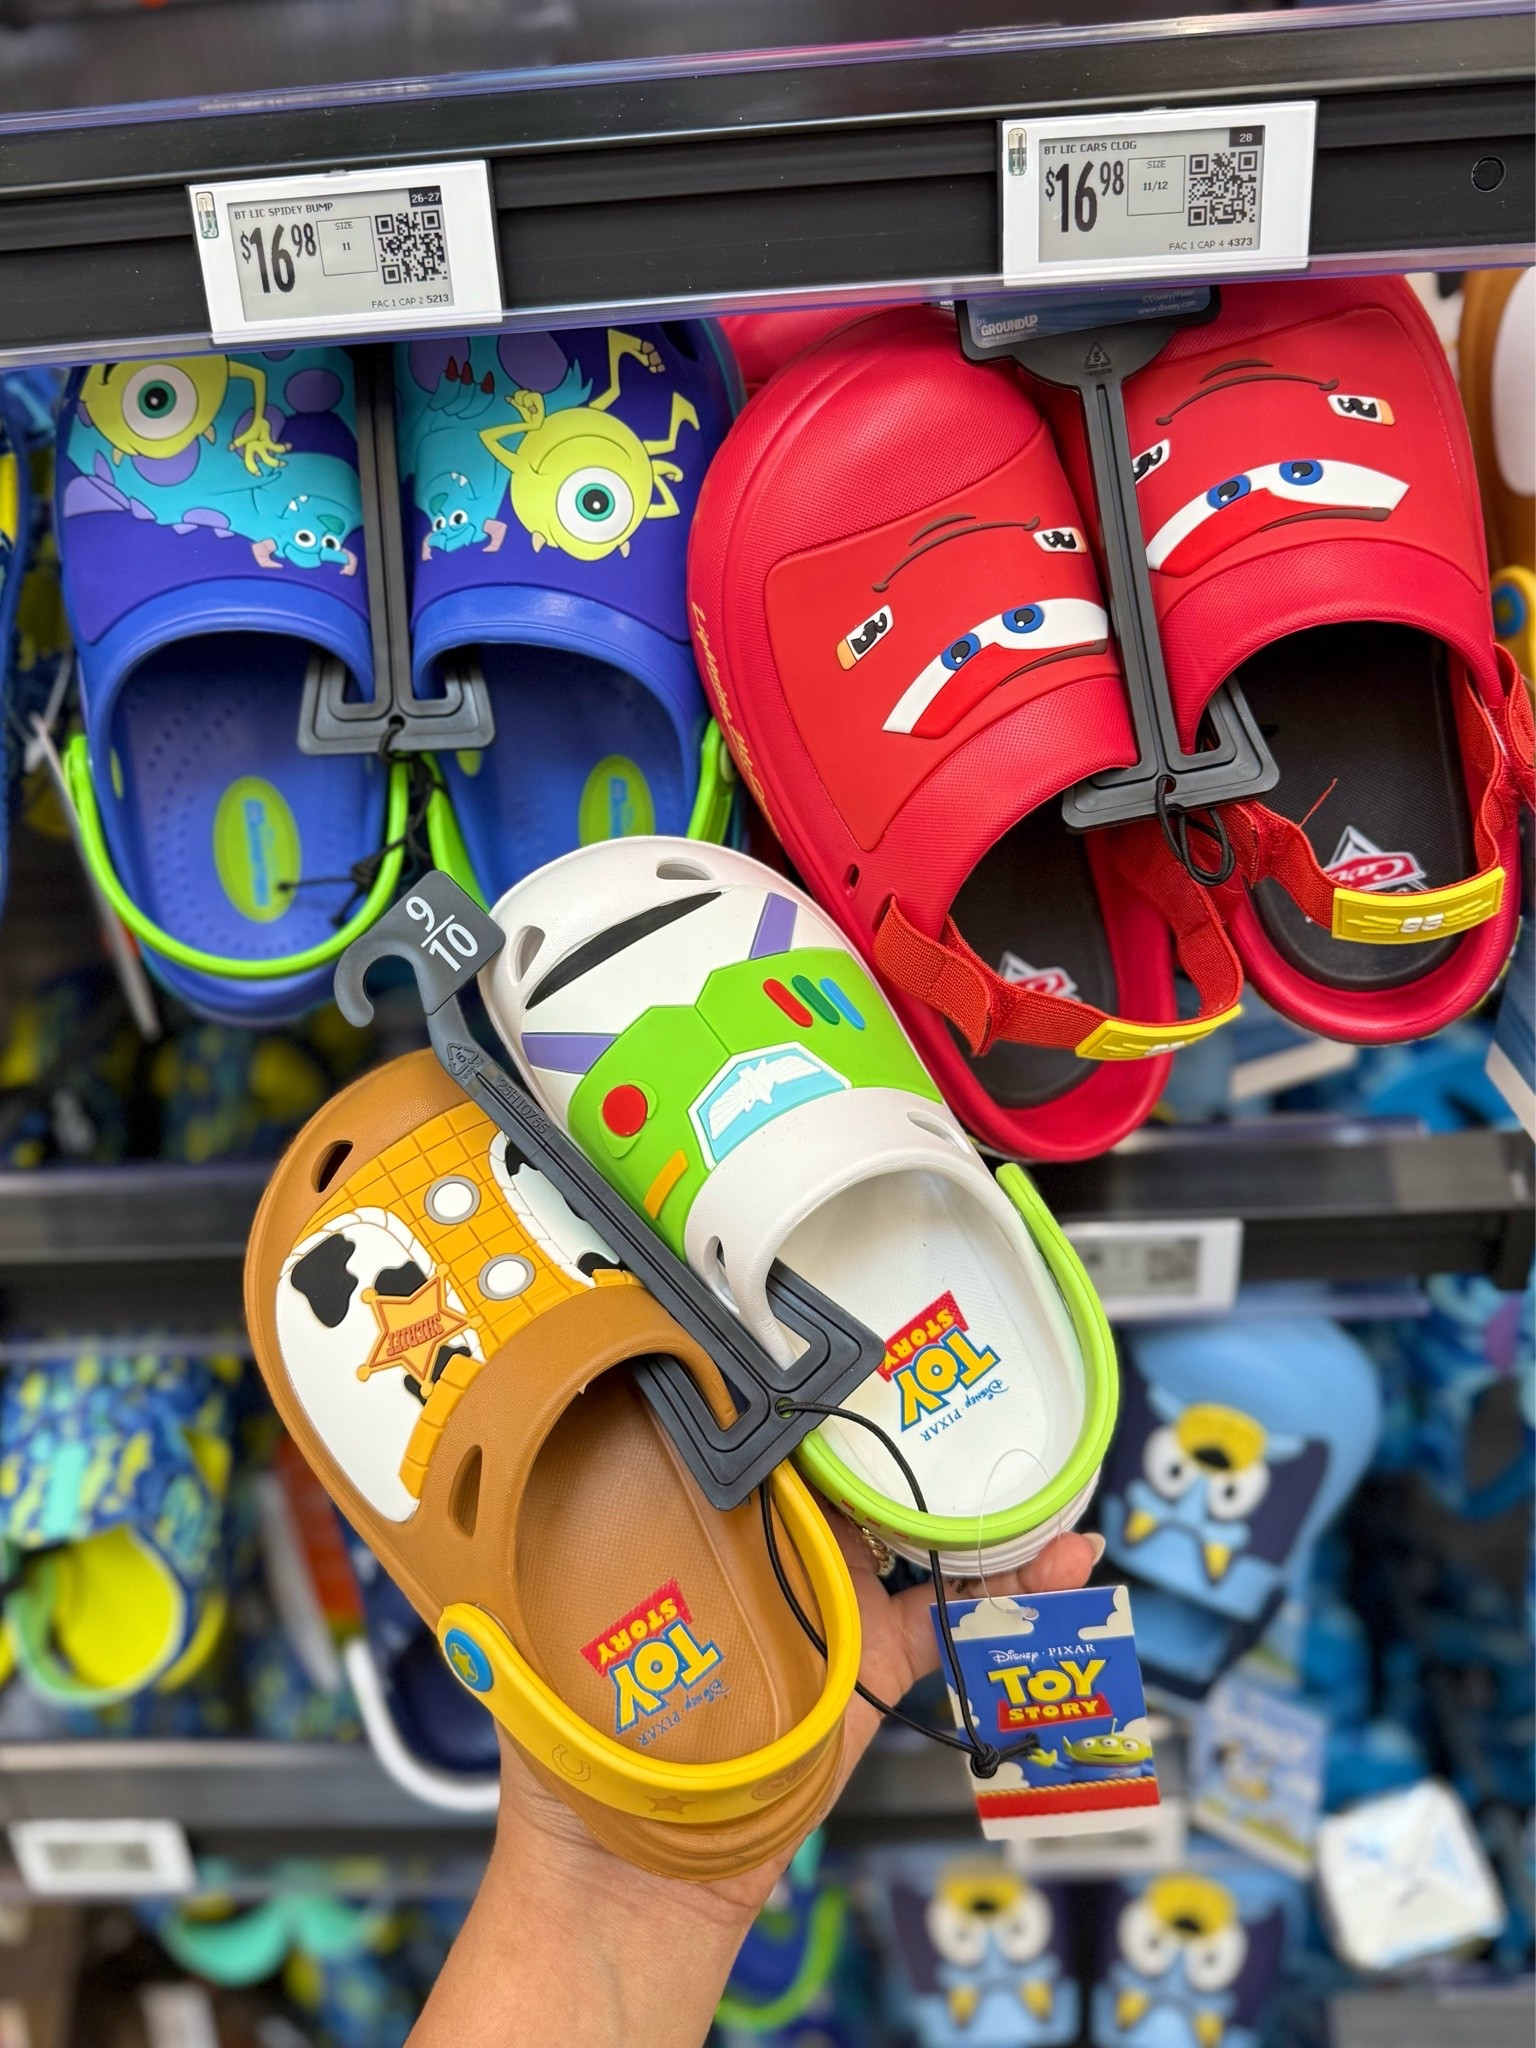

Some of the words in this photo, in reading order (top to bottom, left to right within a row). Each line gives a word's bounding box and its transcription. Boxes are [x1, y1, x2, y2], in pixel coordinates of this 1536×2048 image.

[1044, 145, 1057, 155] BT
[1060, 143, 1077, 154] LIC
[1079, 142, 1107, 153] CARS
[1110, 140, 1137, 151] CLOG
[1239, 133, 1253, 143] 28
[1146, 160, 1166, 169] SIZE
[1142, 181, 1168, 191] 11/12
[411, 192, 440, 203] 26-27
[234, 210, 248, 220] BT
[249, 208, 266, 218] LIC
[268, 205, 303, 217] SPIDEY
[305, 202, 334, 213] BUMP
[335, 221, 353, 230] SIZE
[342, 243, 351, 251] 11
[1168, 242, 1187, 251] FAC
[1197, 240, 1216, 250] CAP
[1218, 240, 1225, 248] 4
[1227, 237, 1253, 248] 4373
[371, 300, 390, 309] FAC
[398, 297, 416, 306] CAP
[426, 294, 449, 304] 5213
[980, 314, 1039, 337] GROUNDUP
[386, 1311, 445, 1357] SHERIFF
[883, 1308, 954, 1371] STORY
[893, 1326, 1000, 1431] TOY
[965, 1379, 1009, 1409] Disney
[920, 1408, 963, 1442] PIXAR
[597, 1597, 678, 1665] STORY
[988, 1649, 1039, 1664] Disney
[1047, 1643, 1096, 1656] PIXAR
[608, 1617, 724, 1735] TOY
[987, 1659, 1108, 1705] TOY
[1008, 1700, 1100, 1722] STORY
[637, 1711, 683, 1746] PIXAR
